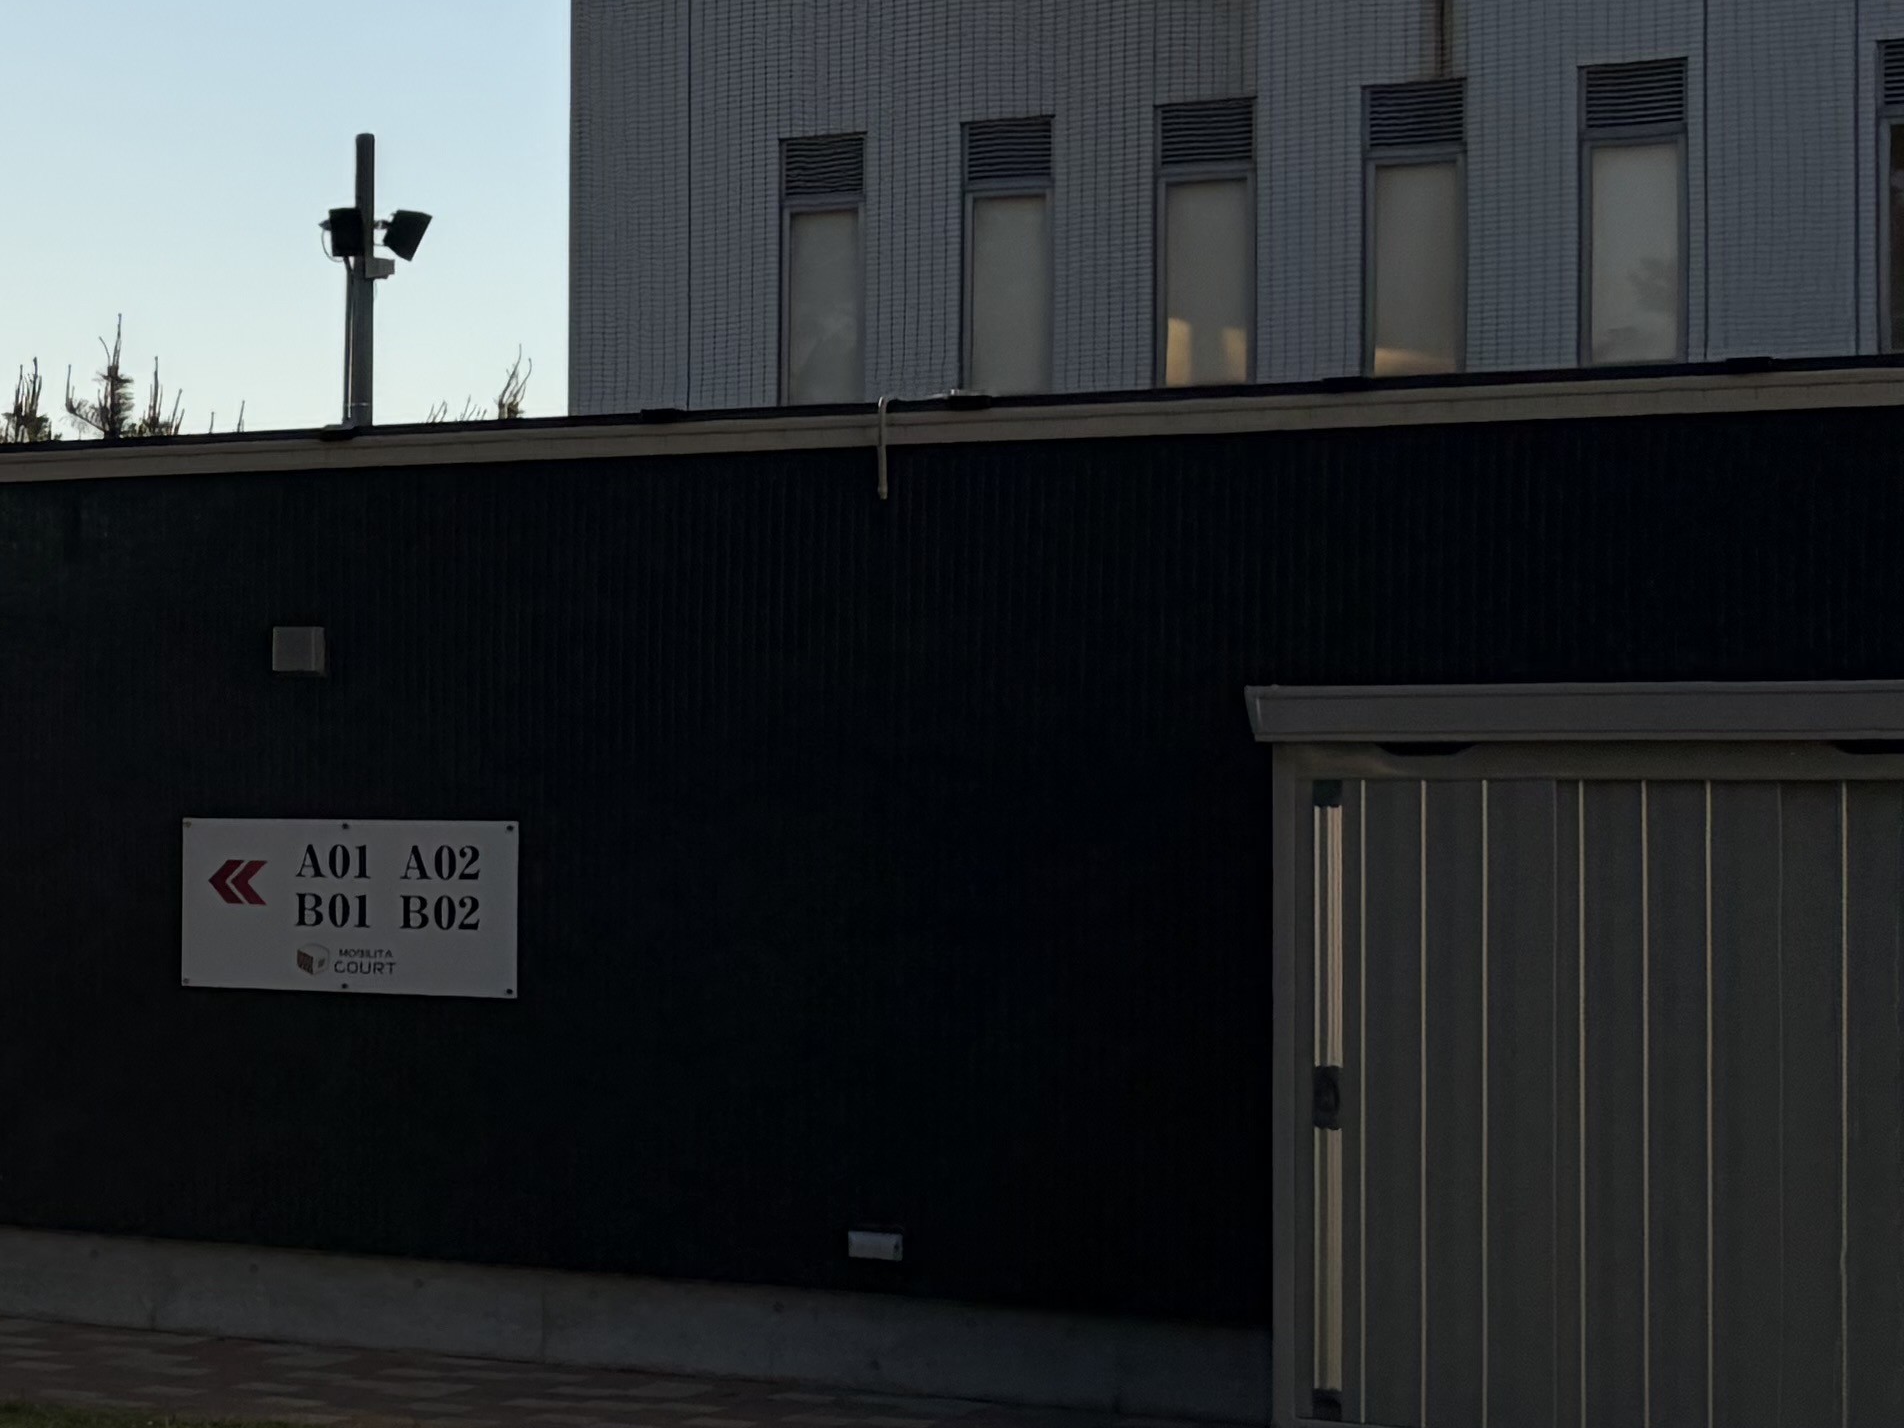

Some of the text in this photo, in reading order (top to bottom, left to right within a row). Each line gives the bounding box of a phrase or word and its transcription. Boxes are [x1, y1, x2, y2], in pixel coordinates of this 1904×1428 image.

[295, 843, 481, 881] A01 A02
[295, 892, 481, 931] B01 B02
[334, 961, 396, 974] COURT
